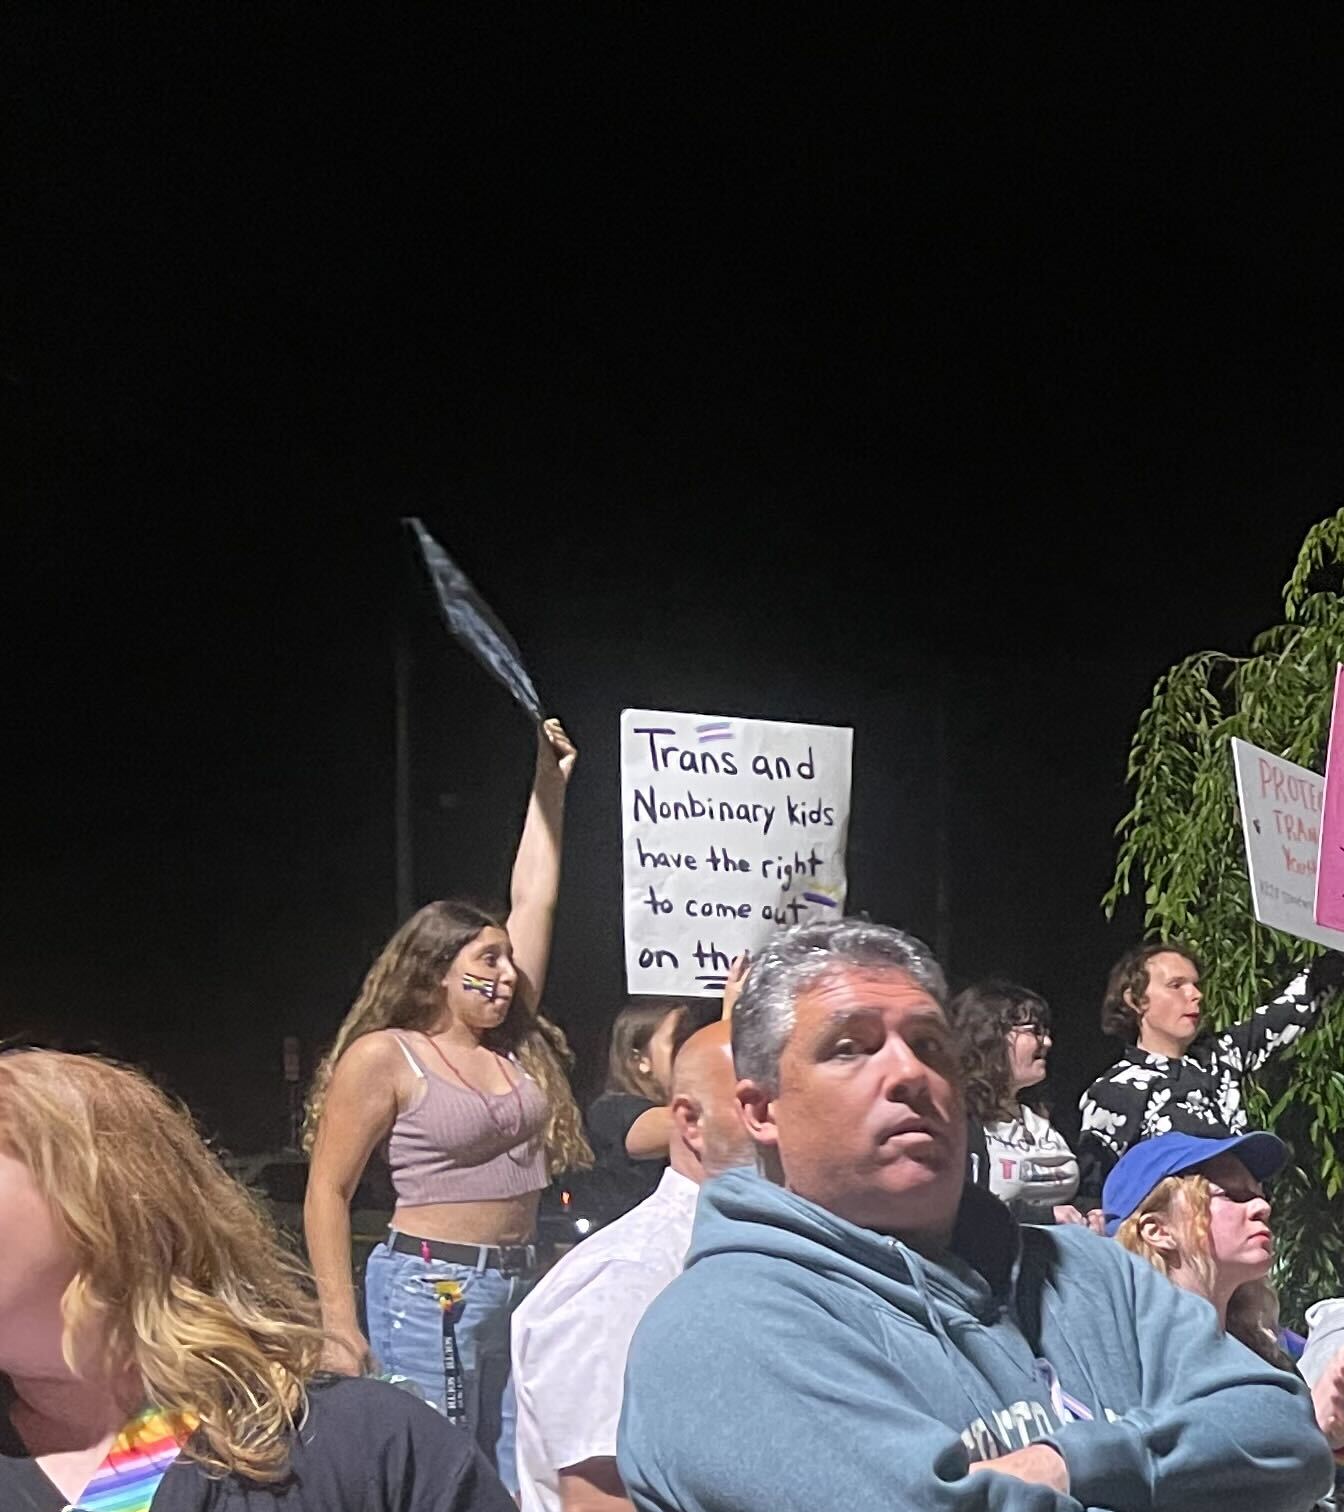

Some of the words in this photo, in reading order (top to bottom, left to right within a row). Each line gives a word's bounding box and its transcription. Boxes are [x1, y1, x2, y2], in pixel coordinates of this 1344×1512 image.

[634, 728, 738, 776] Trans
[752, 747, 815, 780] and
[1258, 757, 1324, 811] PROTE
[634, 785, 775, 835] Nonbinary
[787, 795, 834, 827] kids
[1273, 809, 1319, 844] TRAN
[636, 838, 698, 870] have
[706, 846, 752, 872] the
[762, 847, 823, 891] right
[643, 886, 673, 915] to
[685, 902, 752, 920] come
[762, 898, 808, 925] out
[638, 948, 679, 969] on
